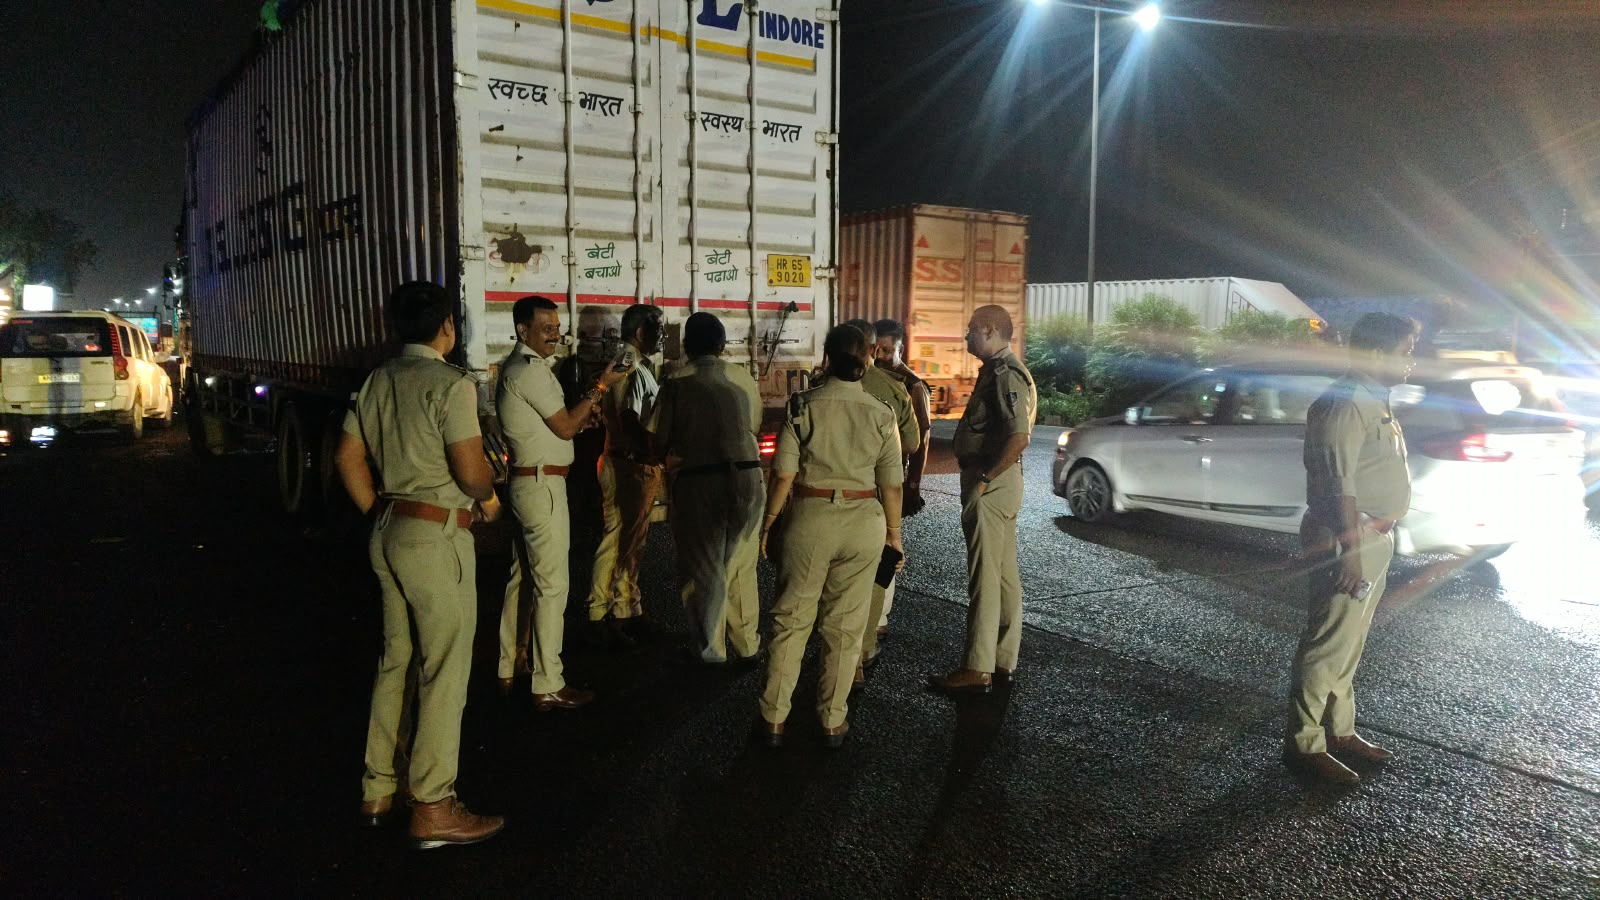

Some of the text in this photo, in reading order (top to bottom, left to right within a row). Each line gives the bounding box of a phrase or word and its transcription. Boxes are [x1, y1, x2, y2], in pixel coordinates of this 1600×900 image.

[758, 10, 824, 49] INDORE
[487, 78, 625, 117] स्वच्छ भारत
[700, 111, 802, 143] स्वस्थ भारत
[585, 241, 616, 259] बेटी
[705, 249, 733, 265] बेटी
[584, 259, 623, 279] बचाओ
[776, 258, 803, 271] HR 65
[776, 271, 804, 283] 9020
